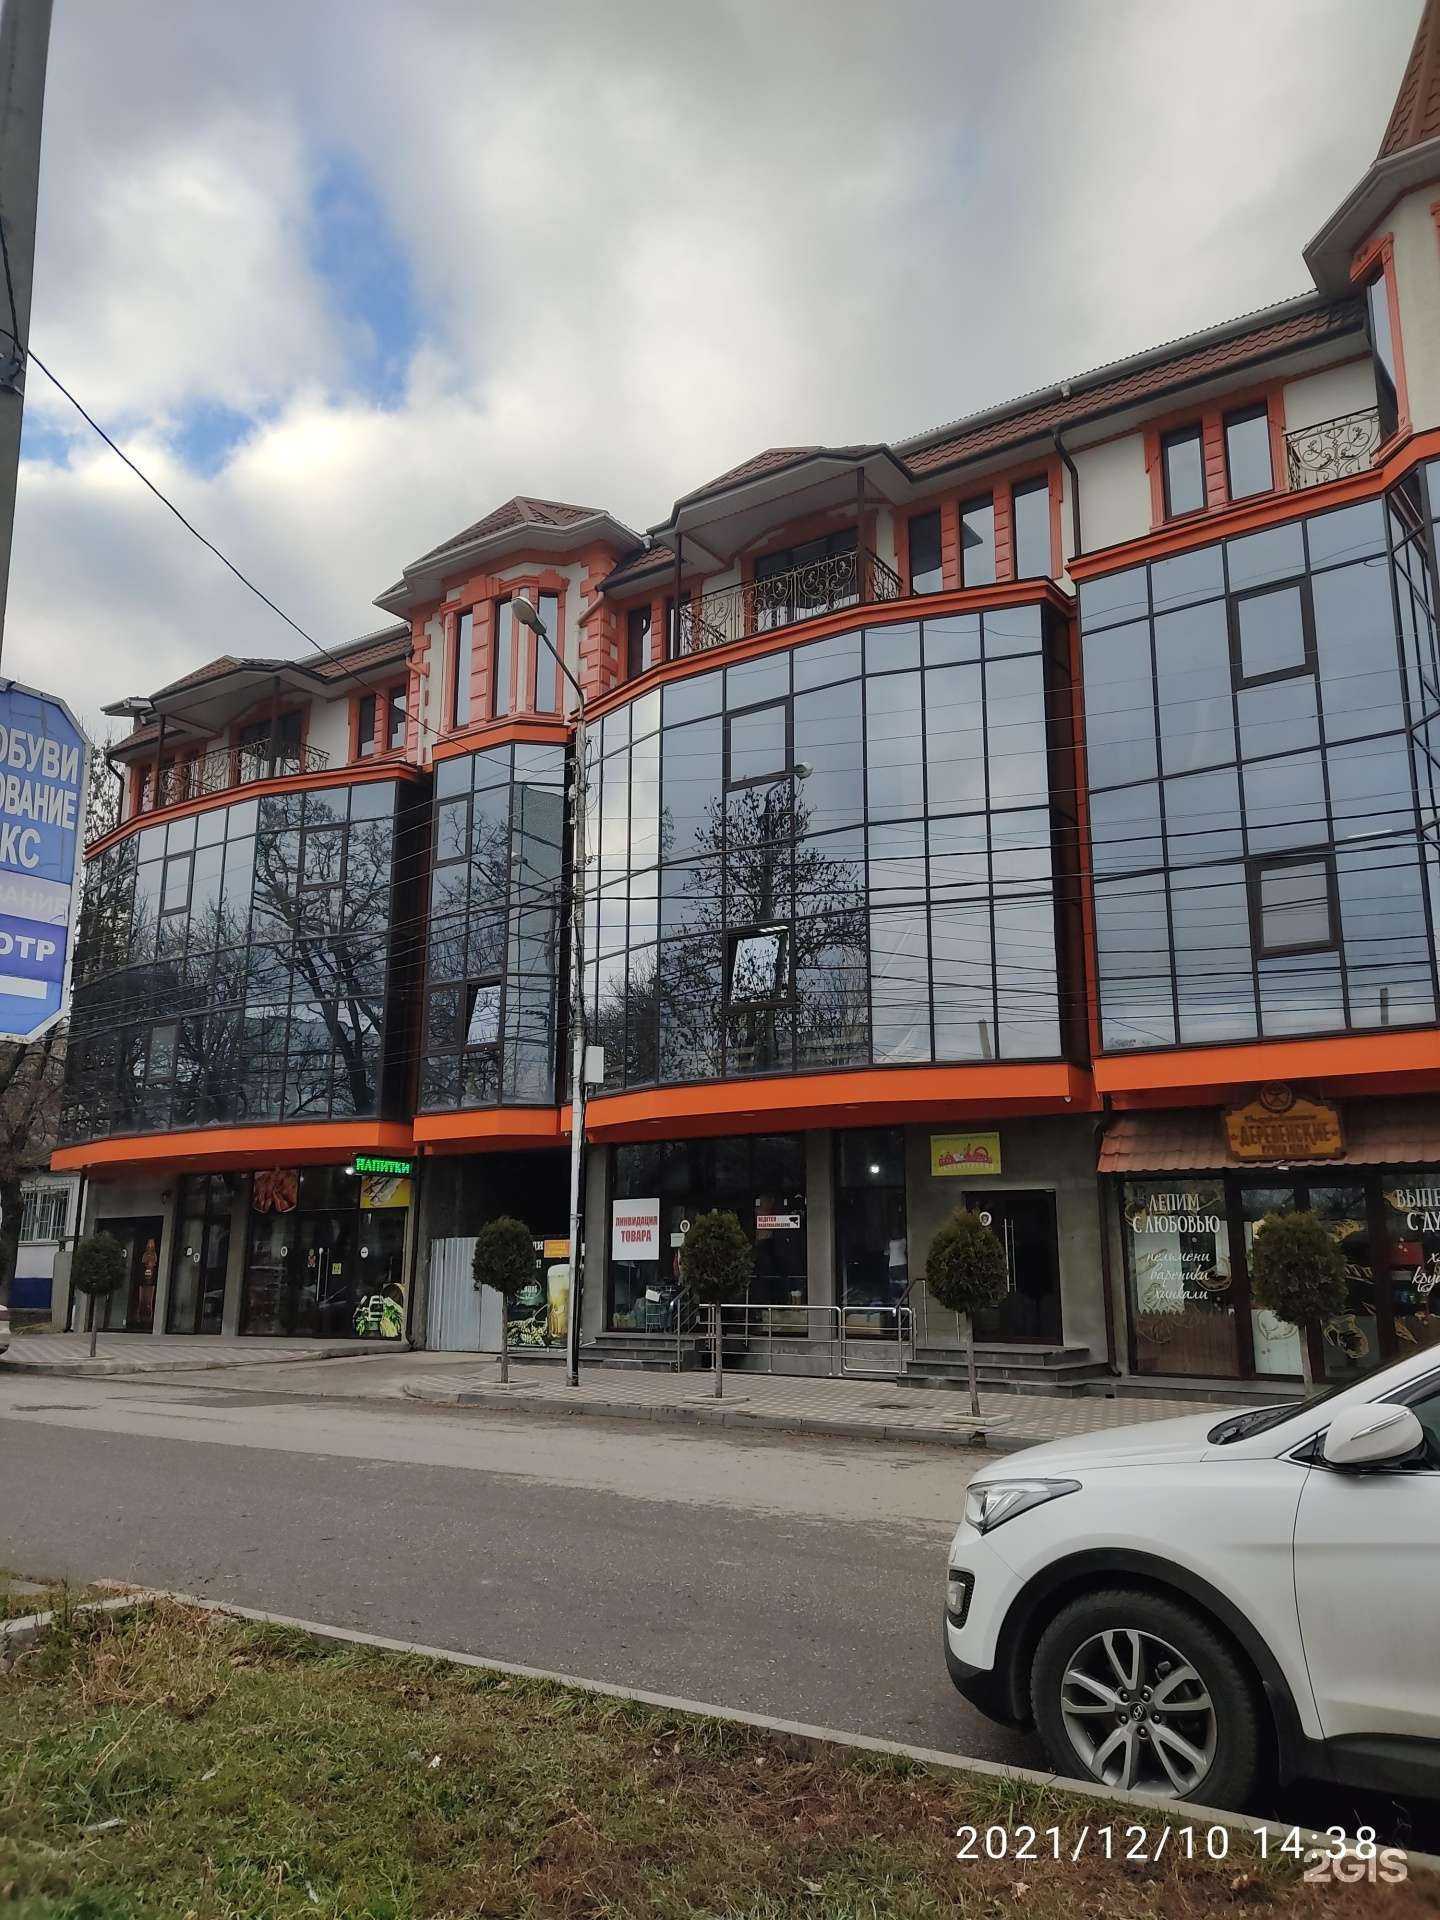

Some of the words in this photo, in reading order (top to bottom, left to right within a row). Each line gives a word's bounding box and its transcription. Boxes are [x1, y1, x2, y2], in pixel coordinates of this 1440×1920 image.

[356, 1158, 410, 1174] НАПИТКИ
[1149, 1193, 1201, 1212] ЛЕПИМ
[1133, 1216, 1142, 1233] С
[1145, 1215, 1221, 1233] ЛЮБОВЬЮ
[1406, 1211, 1419, 1231] С
[620, 1229, 652, 1243] ТОВАРА
